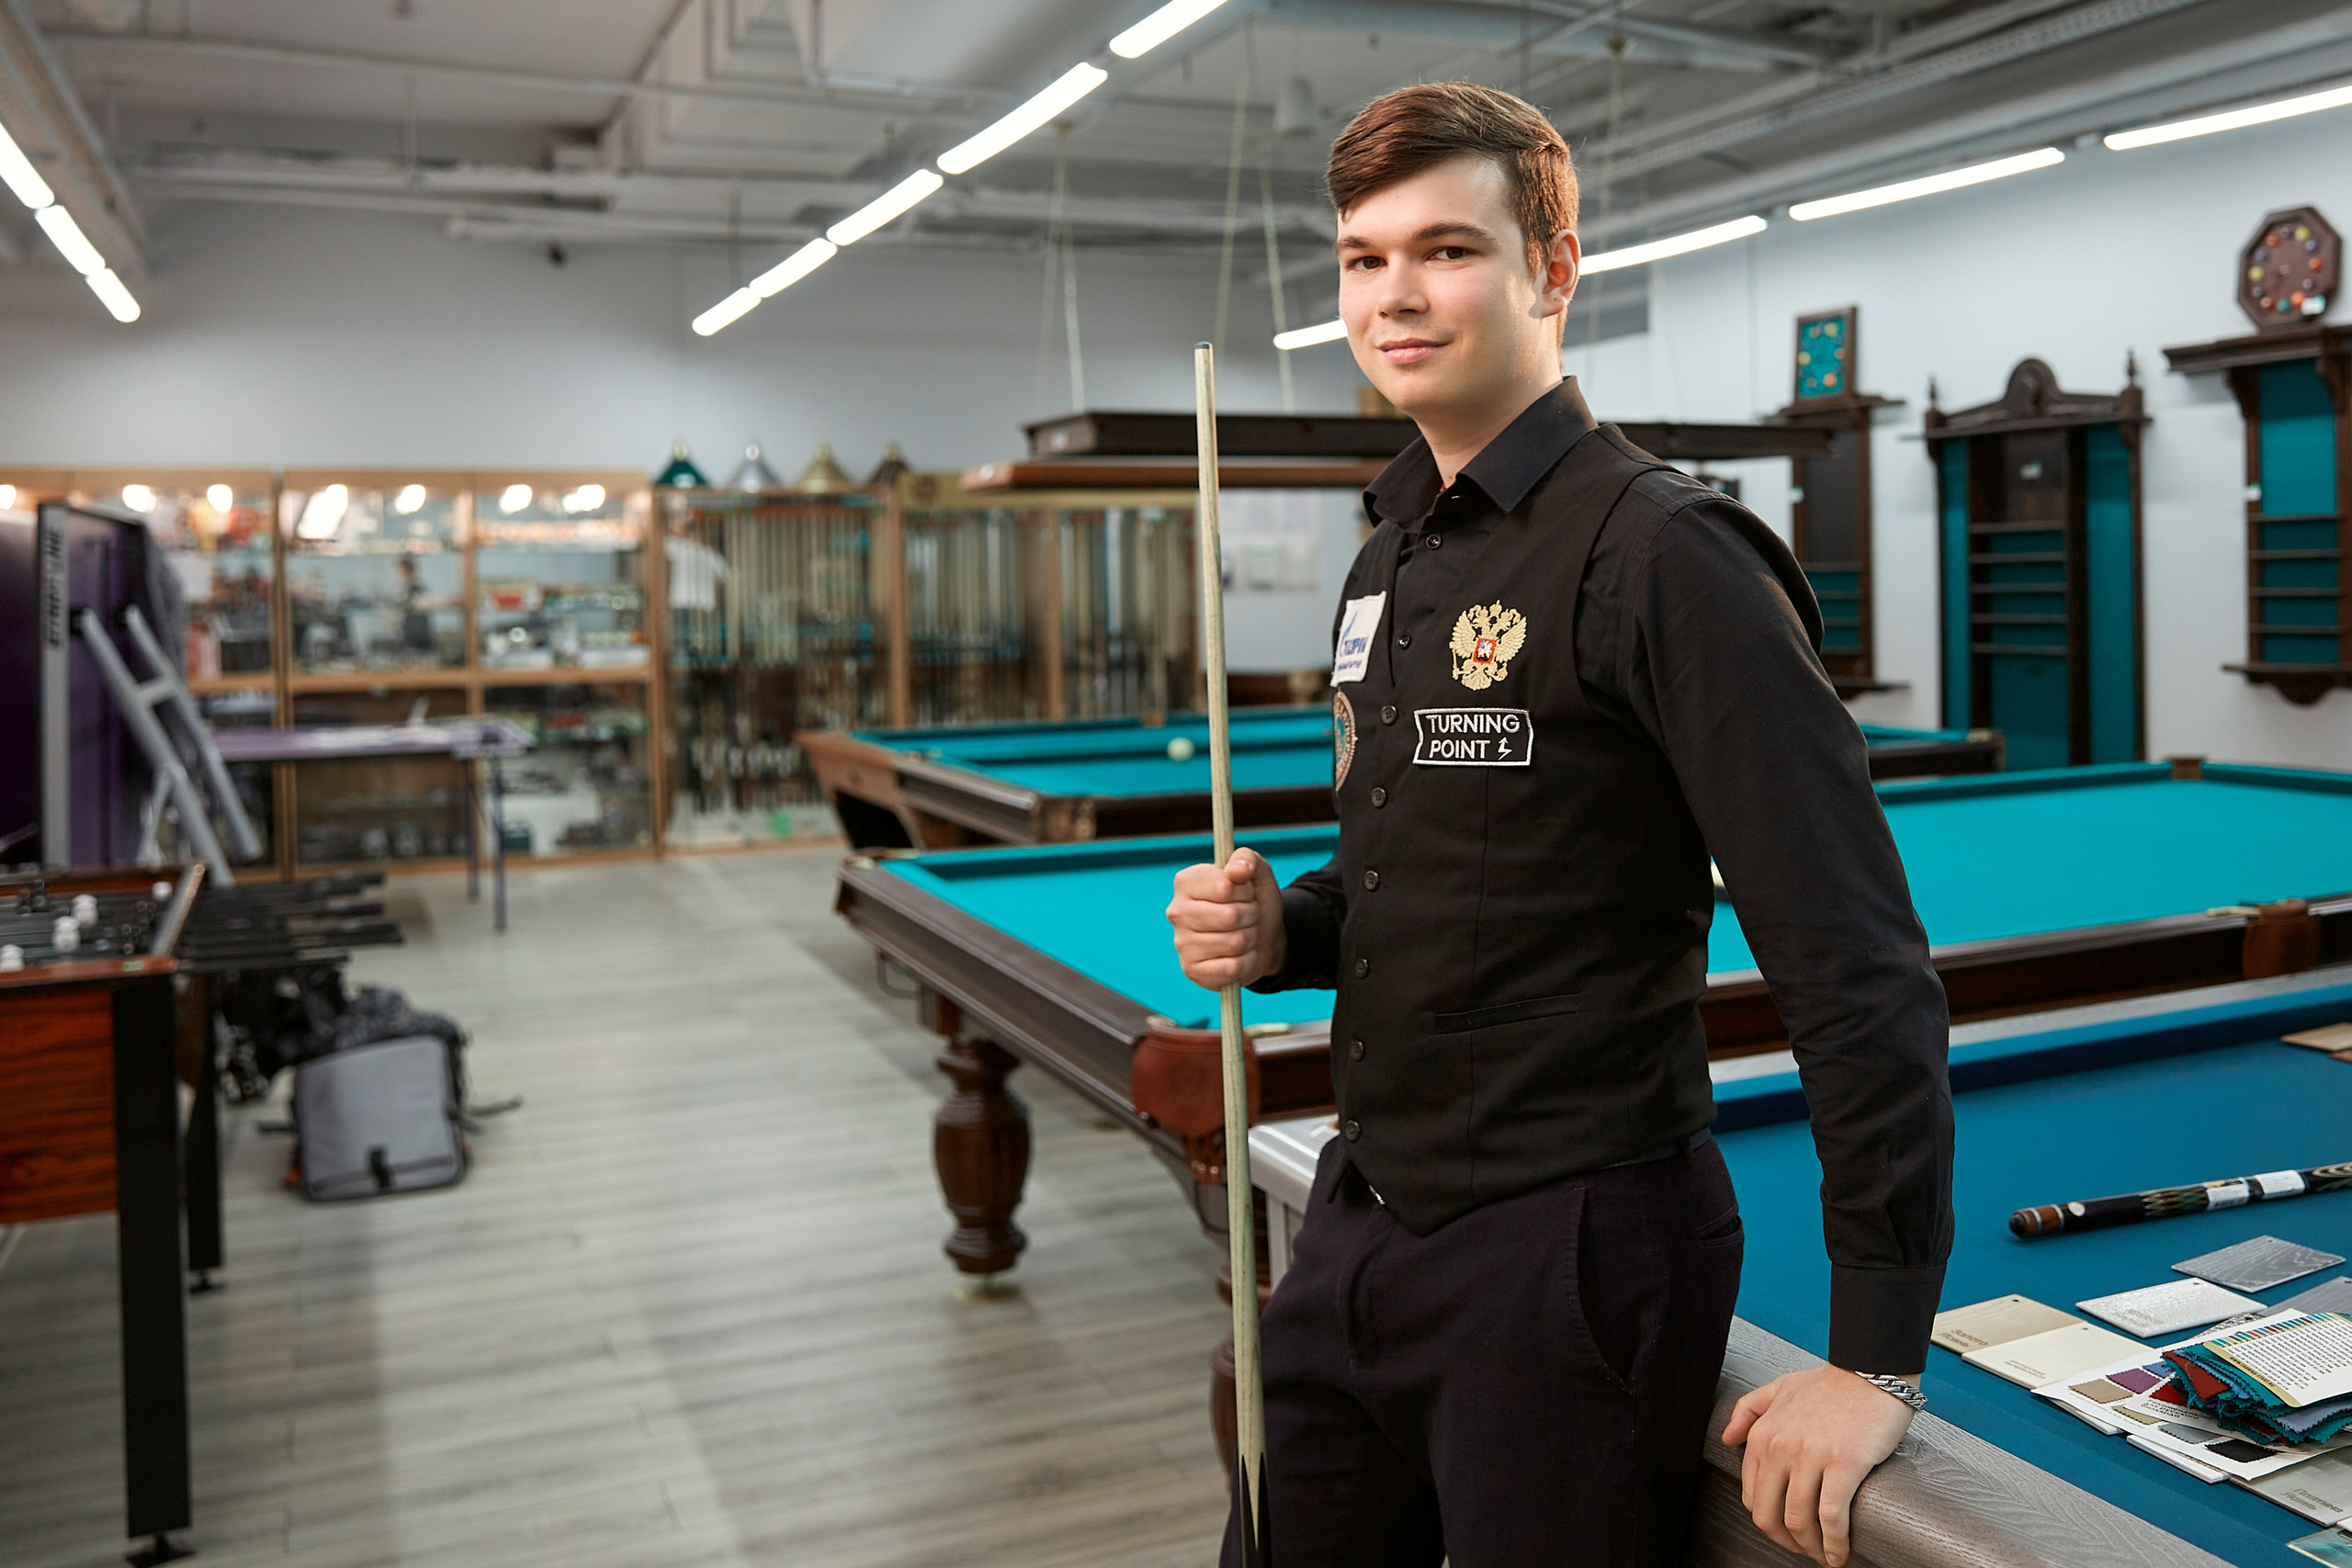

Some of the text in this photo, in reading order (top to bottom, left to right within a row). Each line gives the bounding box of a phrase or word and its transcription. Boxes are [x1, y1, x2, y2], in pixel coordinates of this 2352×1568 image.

[1426, 714, 1521, 734] TURNING
[1429, 739, 1491, 759] POINT
[2293, 1488, 2344, 1513] Платина
